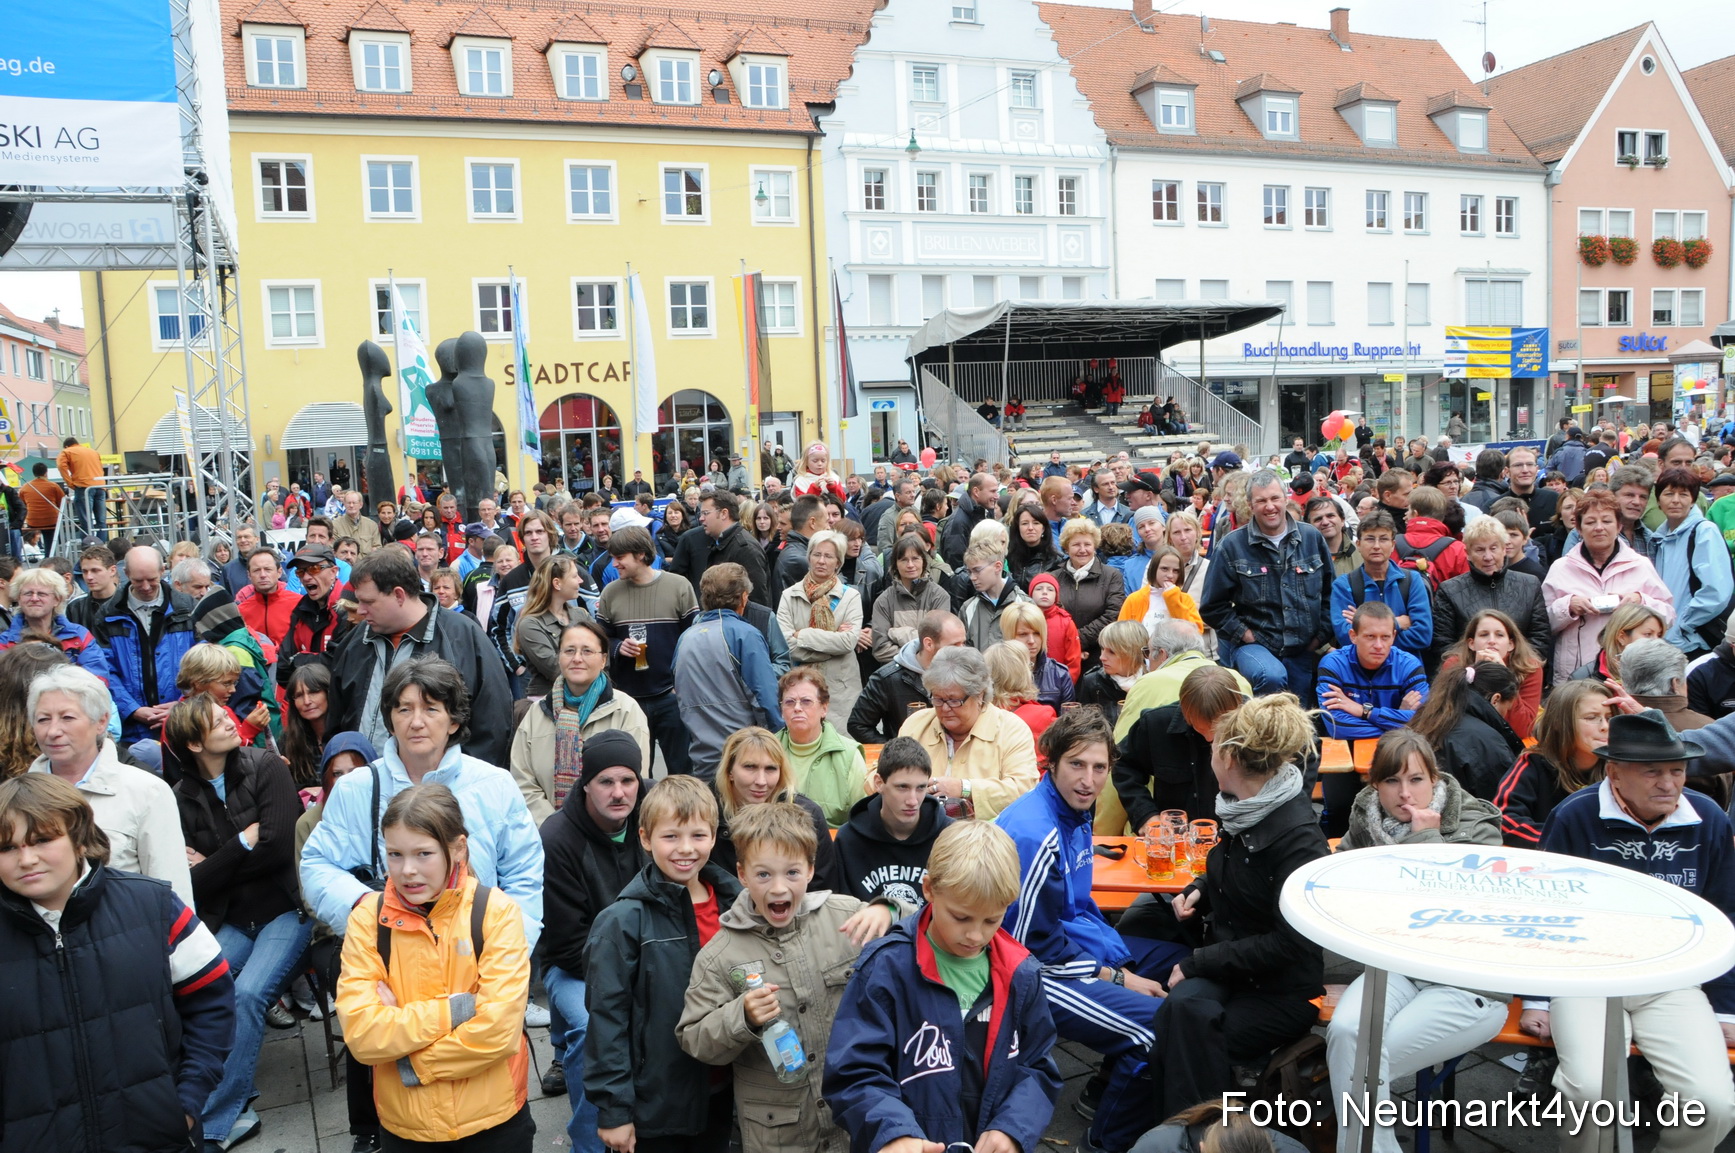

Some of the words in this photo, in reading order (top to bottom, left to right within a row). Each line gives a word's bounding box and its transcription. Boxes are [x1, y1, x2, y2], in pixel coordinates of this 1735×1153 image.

[54, 127, 99, 150] AG
[2, 151, 100, 164] Mediensysteme
[924, 235, 982, 250] BRILLEN
[985, 237, 1037, 252] WEBER
[1244, 341, 1348, 360] Buchhandlung
[504, 361, 631, 386] SADTCAF
[1399, 866, 1588, 893] NEUMARKTER
[1419, 880, 1569, 899] MINERALBRUNNEN
[1408, 908, 1584, 929] Glossner
[1502, 927, 1589, 943] Bier
